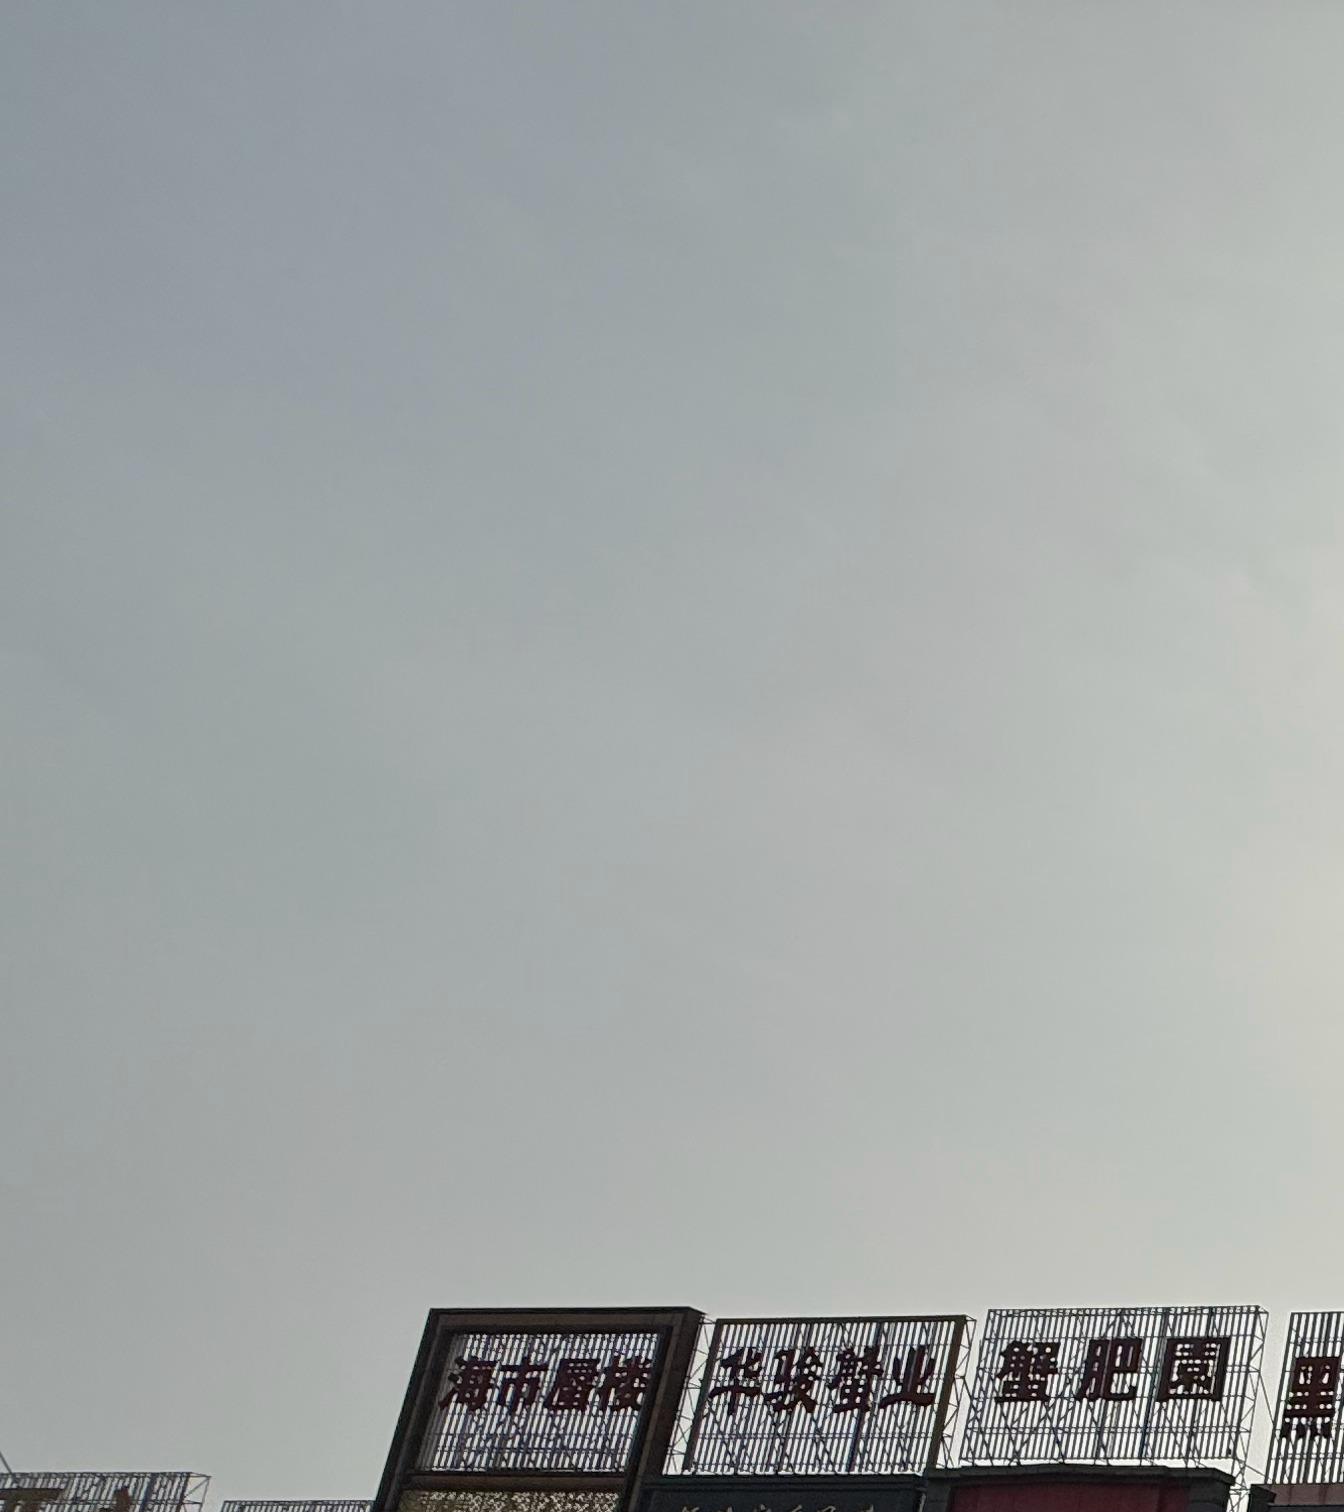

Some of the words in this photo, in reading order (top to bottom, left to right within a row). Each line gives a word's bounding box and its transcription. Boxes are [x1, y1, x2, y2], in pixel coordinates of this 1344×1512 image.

[437, 1356, 653, 1412] 海市蜃楼
[707, 1346, 935, 1415] 华骏蟹业
